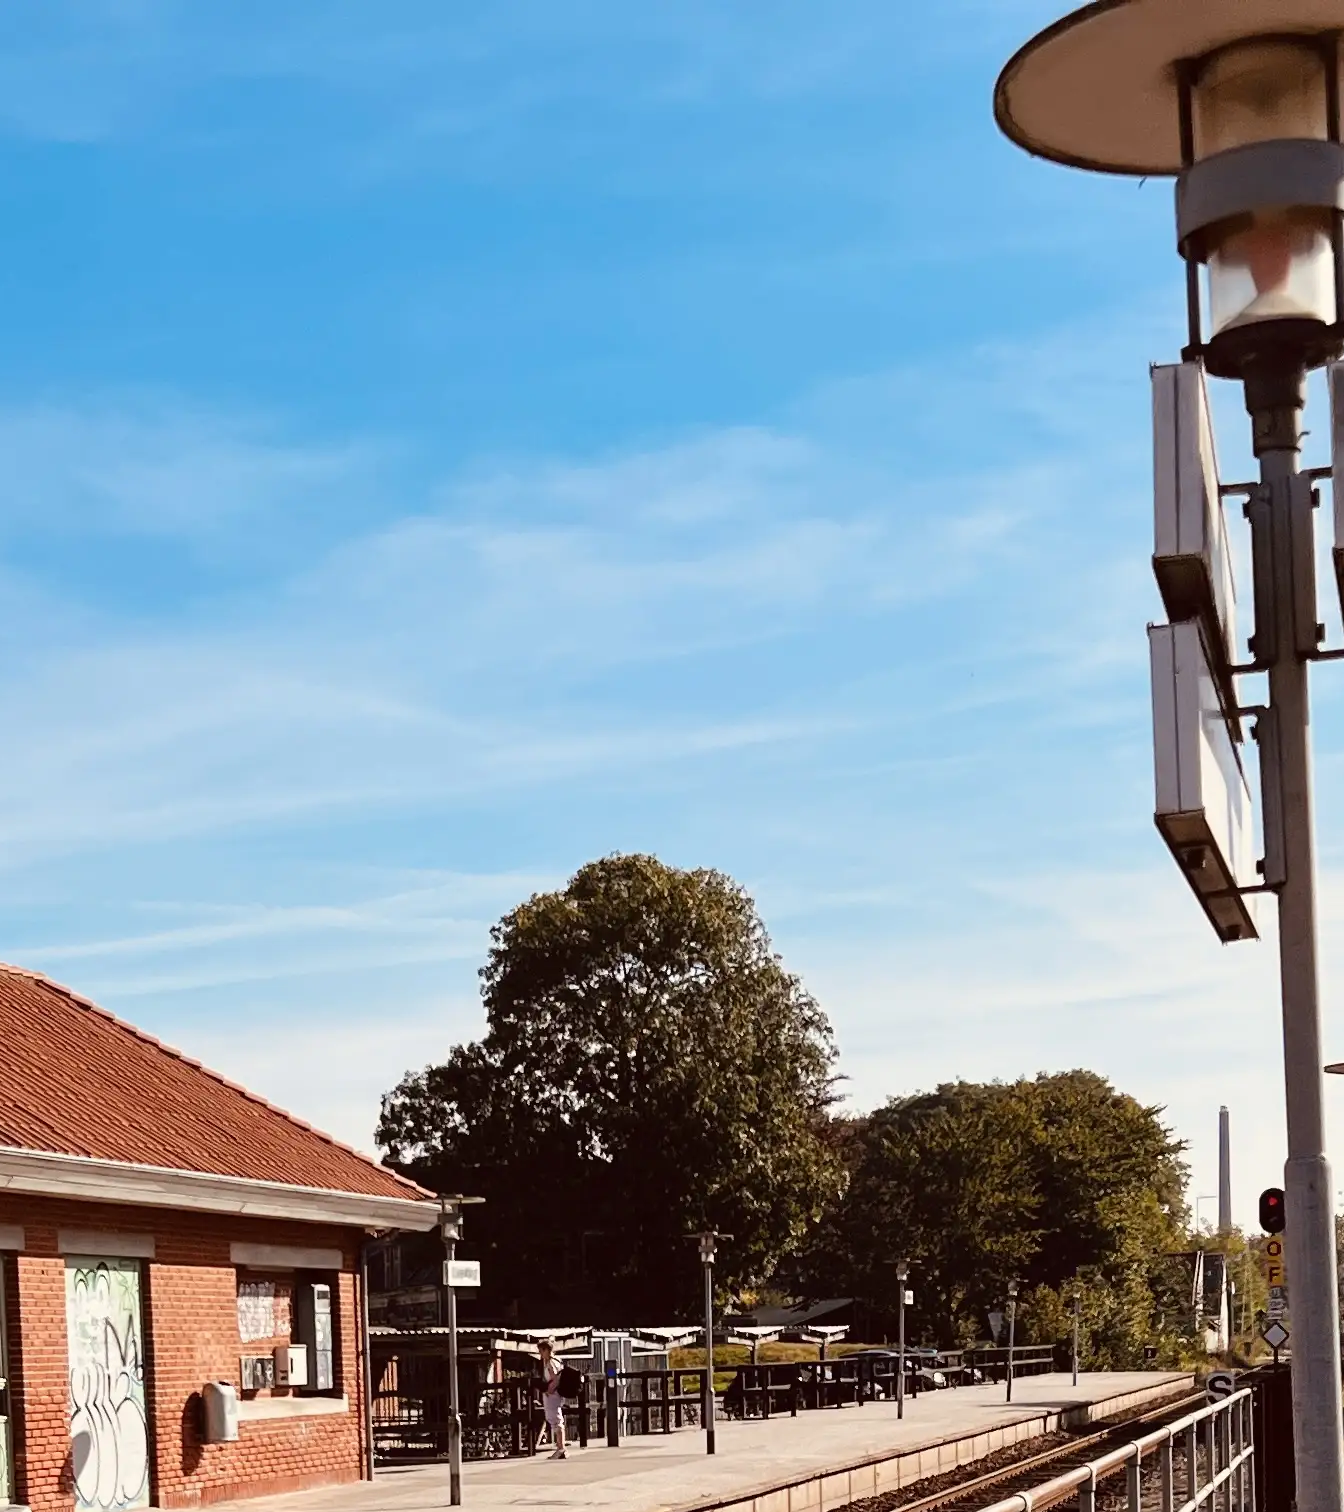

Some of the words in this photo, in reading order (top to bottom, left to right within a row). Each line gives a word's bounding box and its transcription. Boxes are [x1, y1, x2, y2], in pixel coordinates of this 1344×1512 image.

[1266, 1241, 1282, 1256] O
[1268, 1266, 1281, 1282] F
[1208, 1375, 1233, 1404] S
